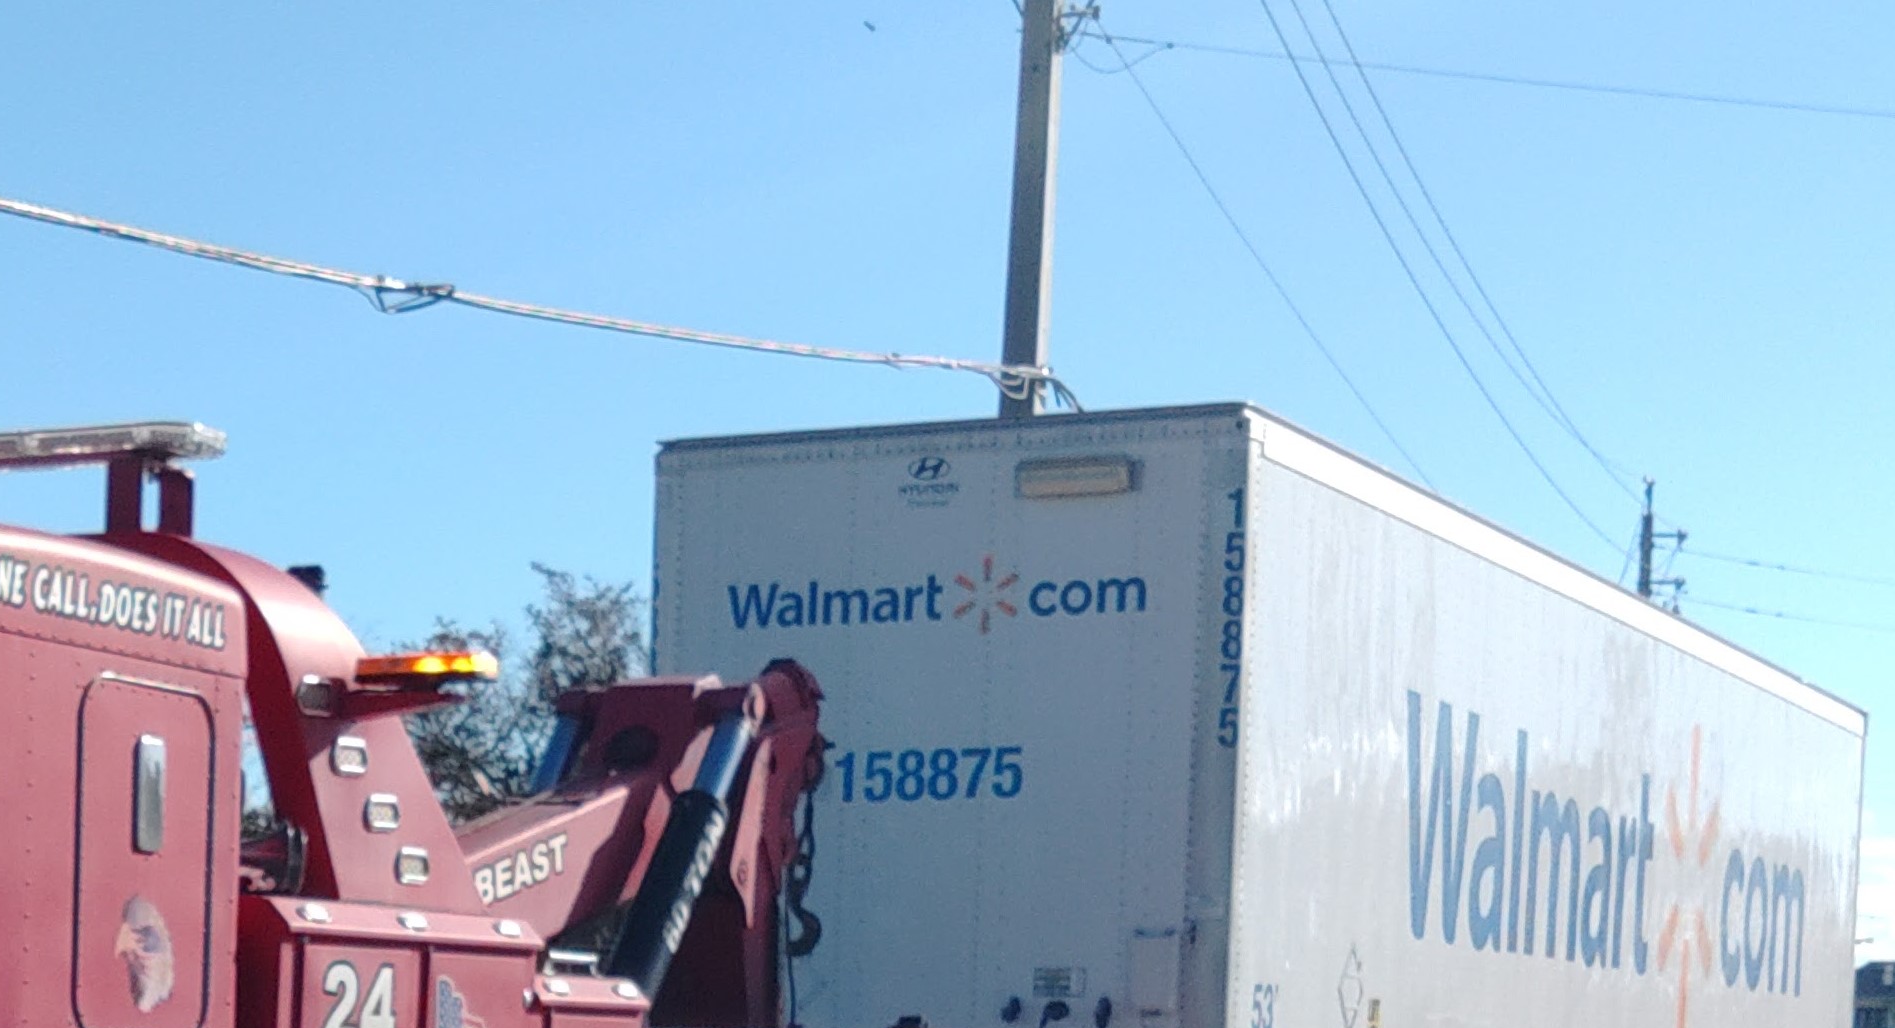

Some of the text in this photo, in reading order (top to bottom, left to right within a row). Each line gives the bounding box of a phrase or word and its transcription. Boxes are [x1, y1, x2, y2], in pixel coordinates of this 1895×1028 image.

[163, 594, 186, 637] IT
[187, 602, 225, 648] ALL
[726, 574, 1147, 630] Walmart com
[1217, 488, 1245, 749] 158875
[835, 746, 1023, 803] 158875
[473, 834, 568, 904] BEAST
[1407, 688, 1804, 998] Walmart com
